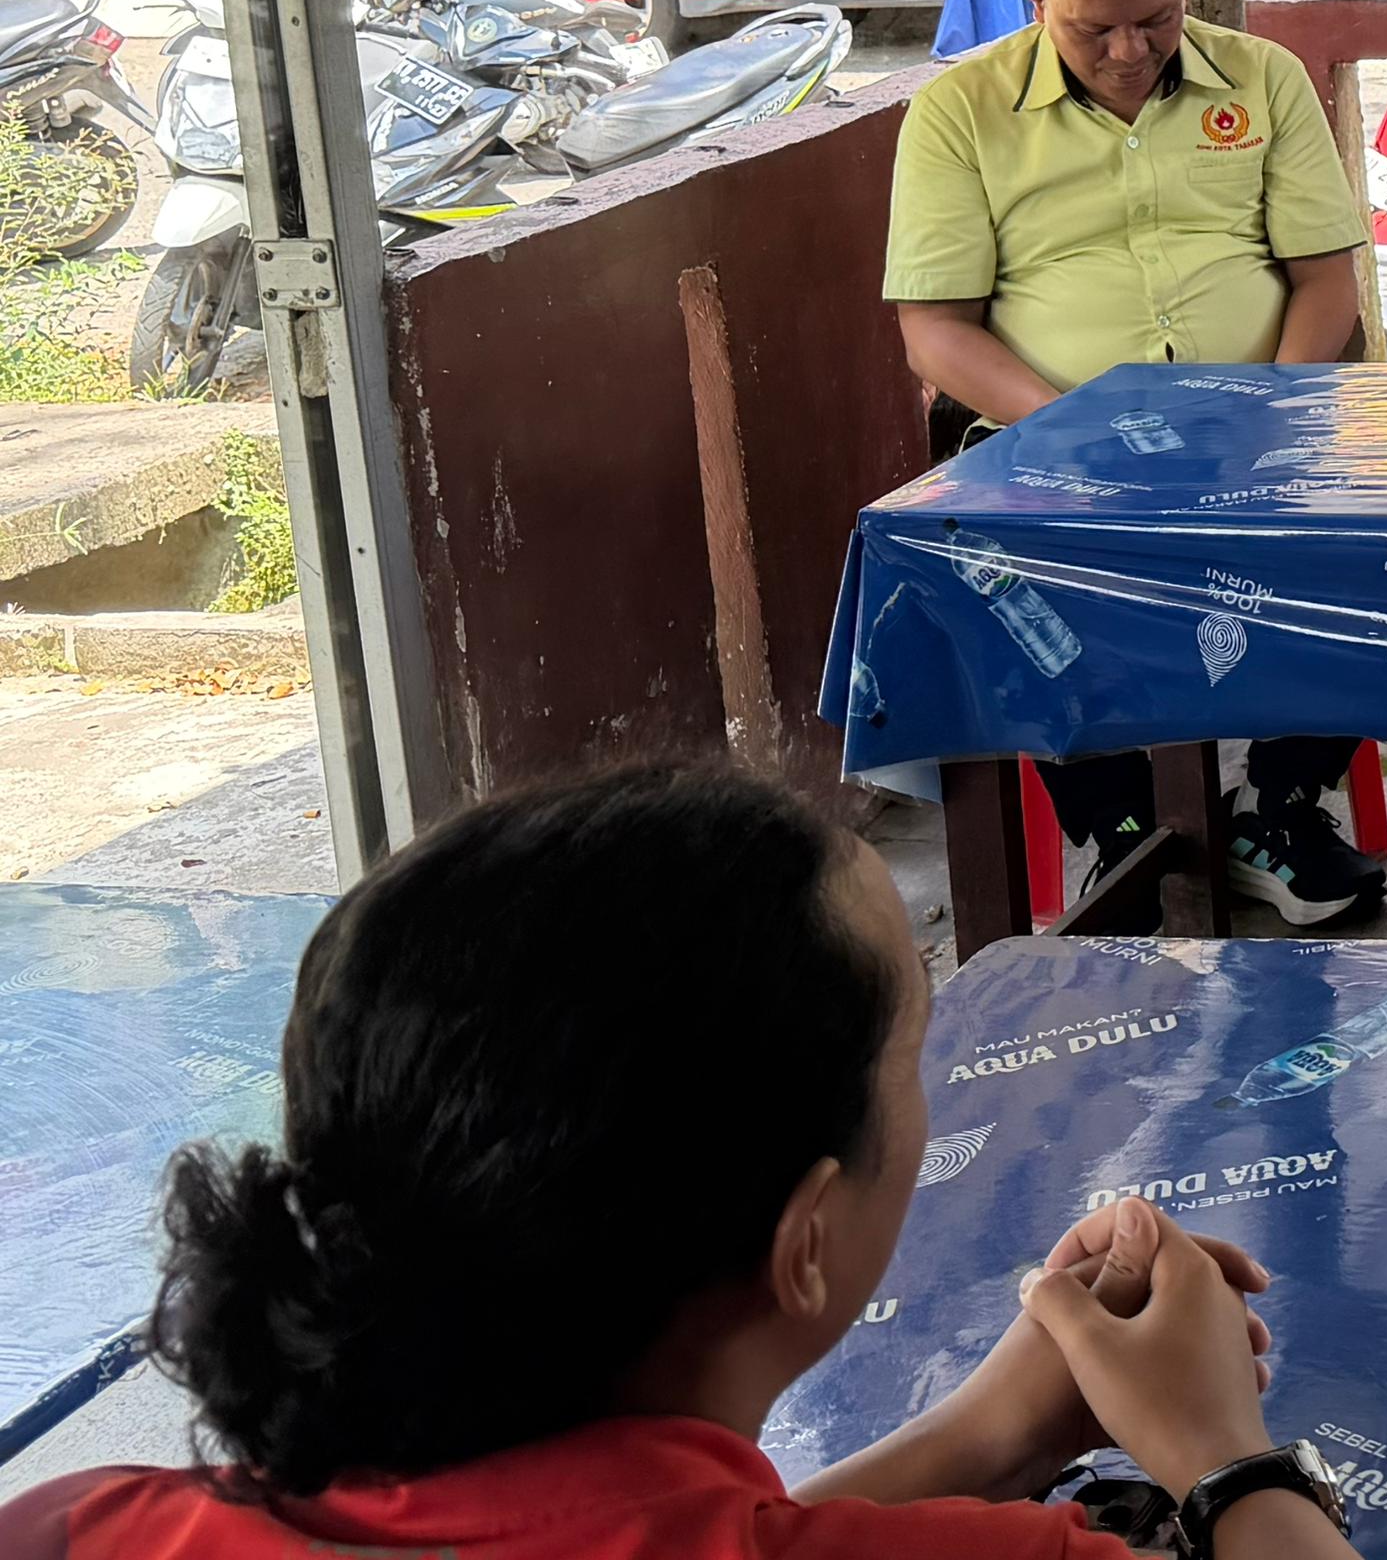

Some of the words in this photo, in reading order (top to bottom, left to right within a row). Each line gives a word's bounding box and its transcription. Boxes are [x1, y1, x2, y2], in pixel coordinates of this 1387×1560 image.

[1205, 567, 1274, 600] MURNI
[1079, 937, 1163, 968] MURNI
[974, 1032, 1032, 1056] MAU
[1036, 1007, 1143, 1040] MAKAN?
[945, 1043, 1057, 1086] AQUA
[1067, 1012, 1179, 1056] DULU
[1286, 1047, 1343, 1078] AQUA
[1219, 1148, 1339, 1187] AQUA
[1277, 1175, 1338, 1196] MAU
